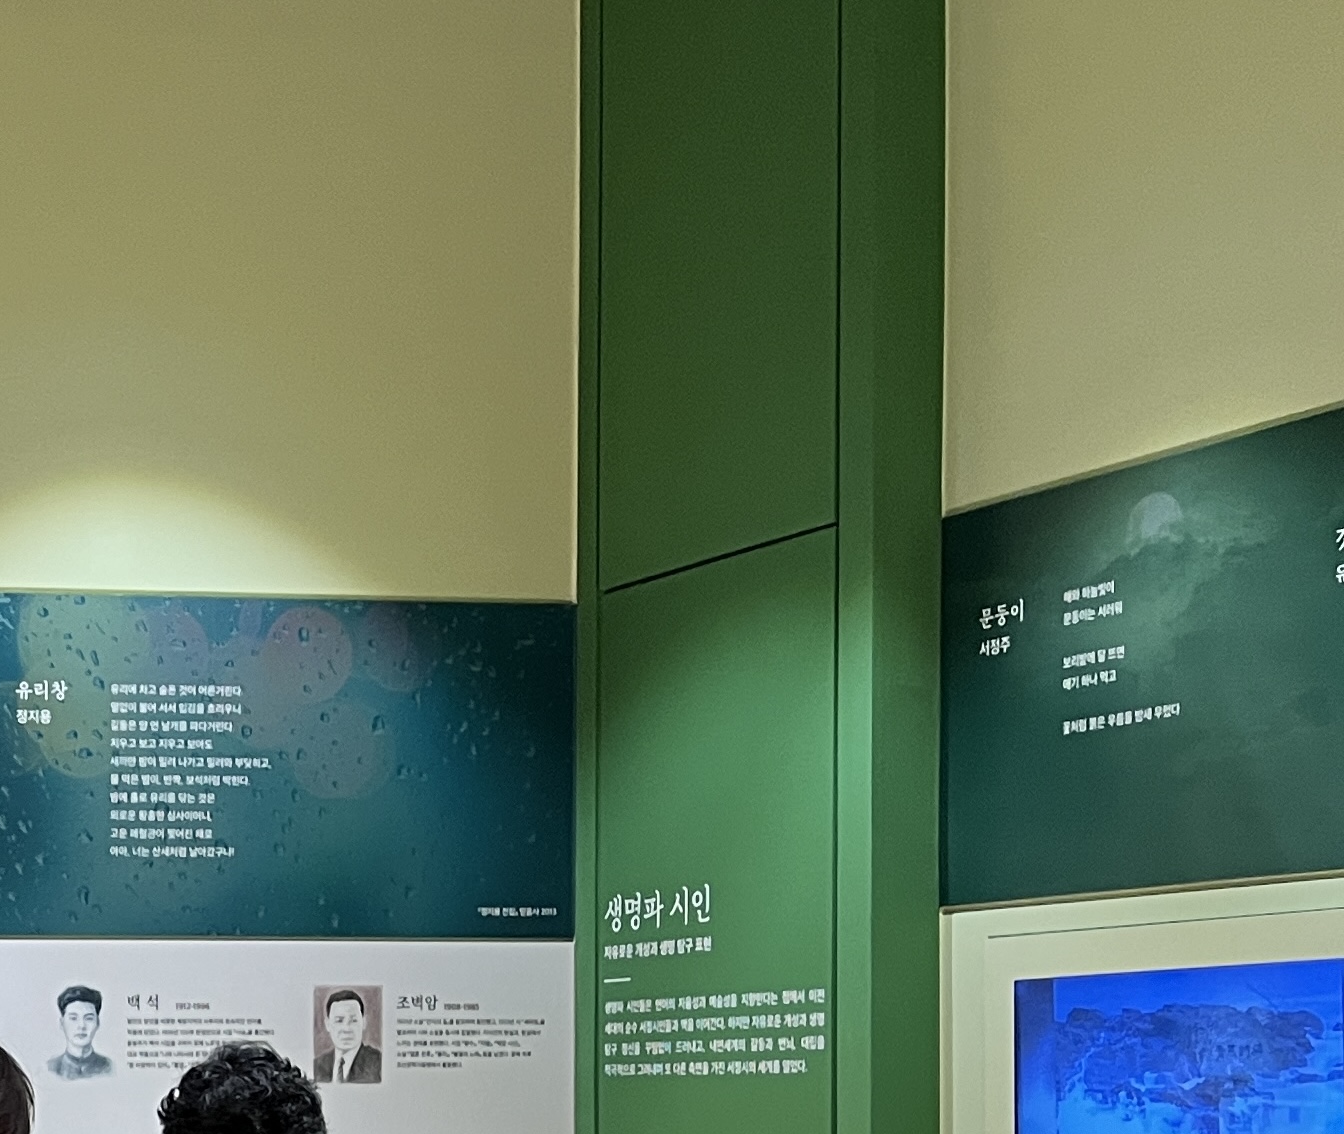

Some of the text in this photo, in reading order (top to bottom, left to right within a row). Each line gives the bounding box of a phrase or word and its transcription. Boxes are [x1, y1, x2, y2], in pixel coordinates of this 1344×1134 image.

[979, 599, 1023, 628] 문둥이
[979, 636, 1010, 655] 서정주
[15, 680, 67, 700] 유리창
[16, 709, 51, 724] 정지용
[604, 883, 709, 931] 생명파 시인
